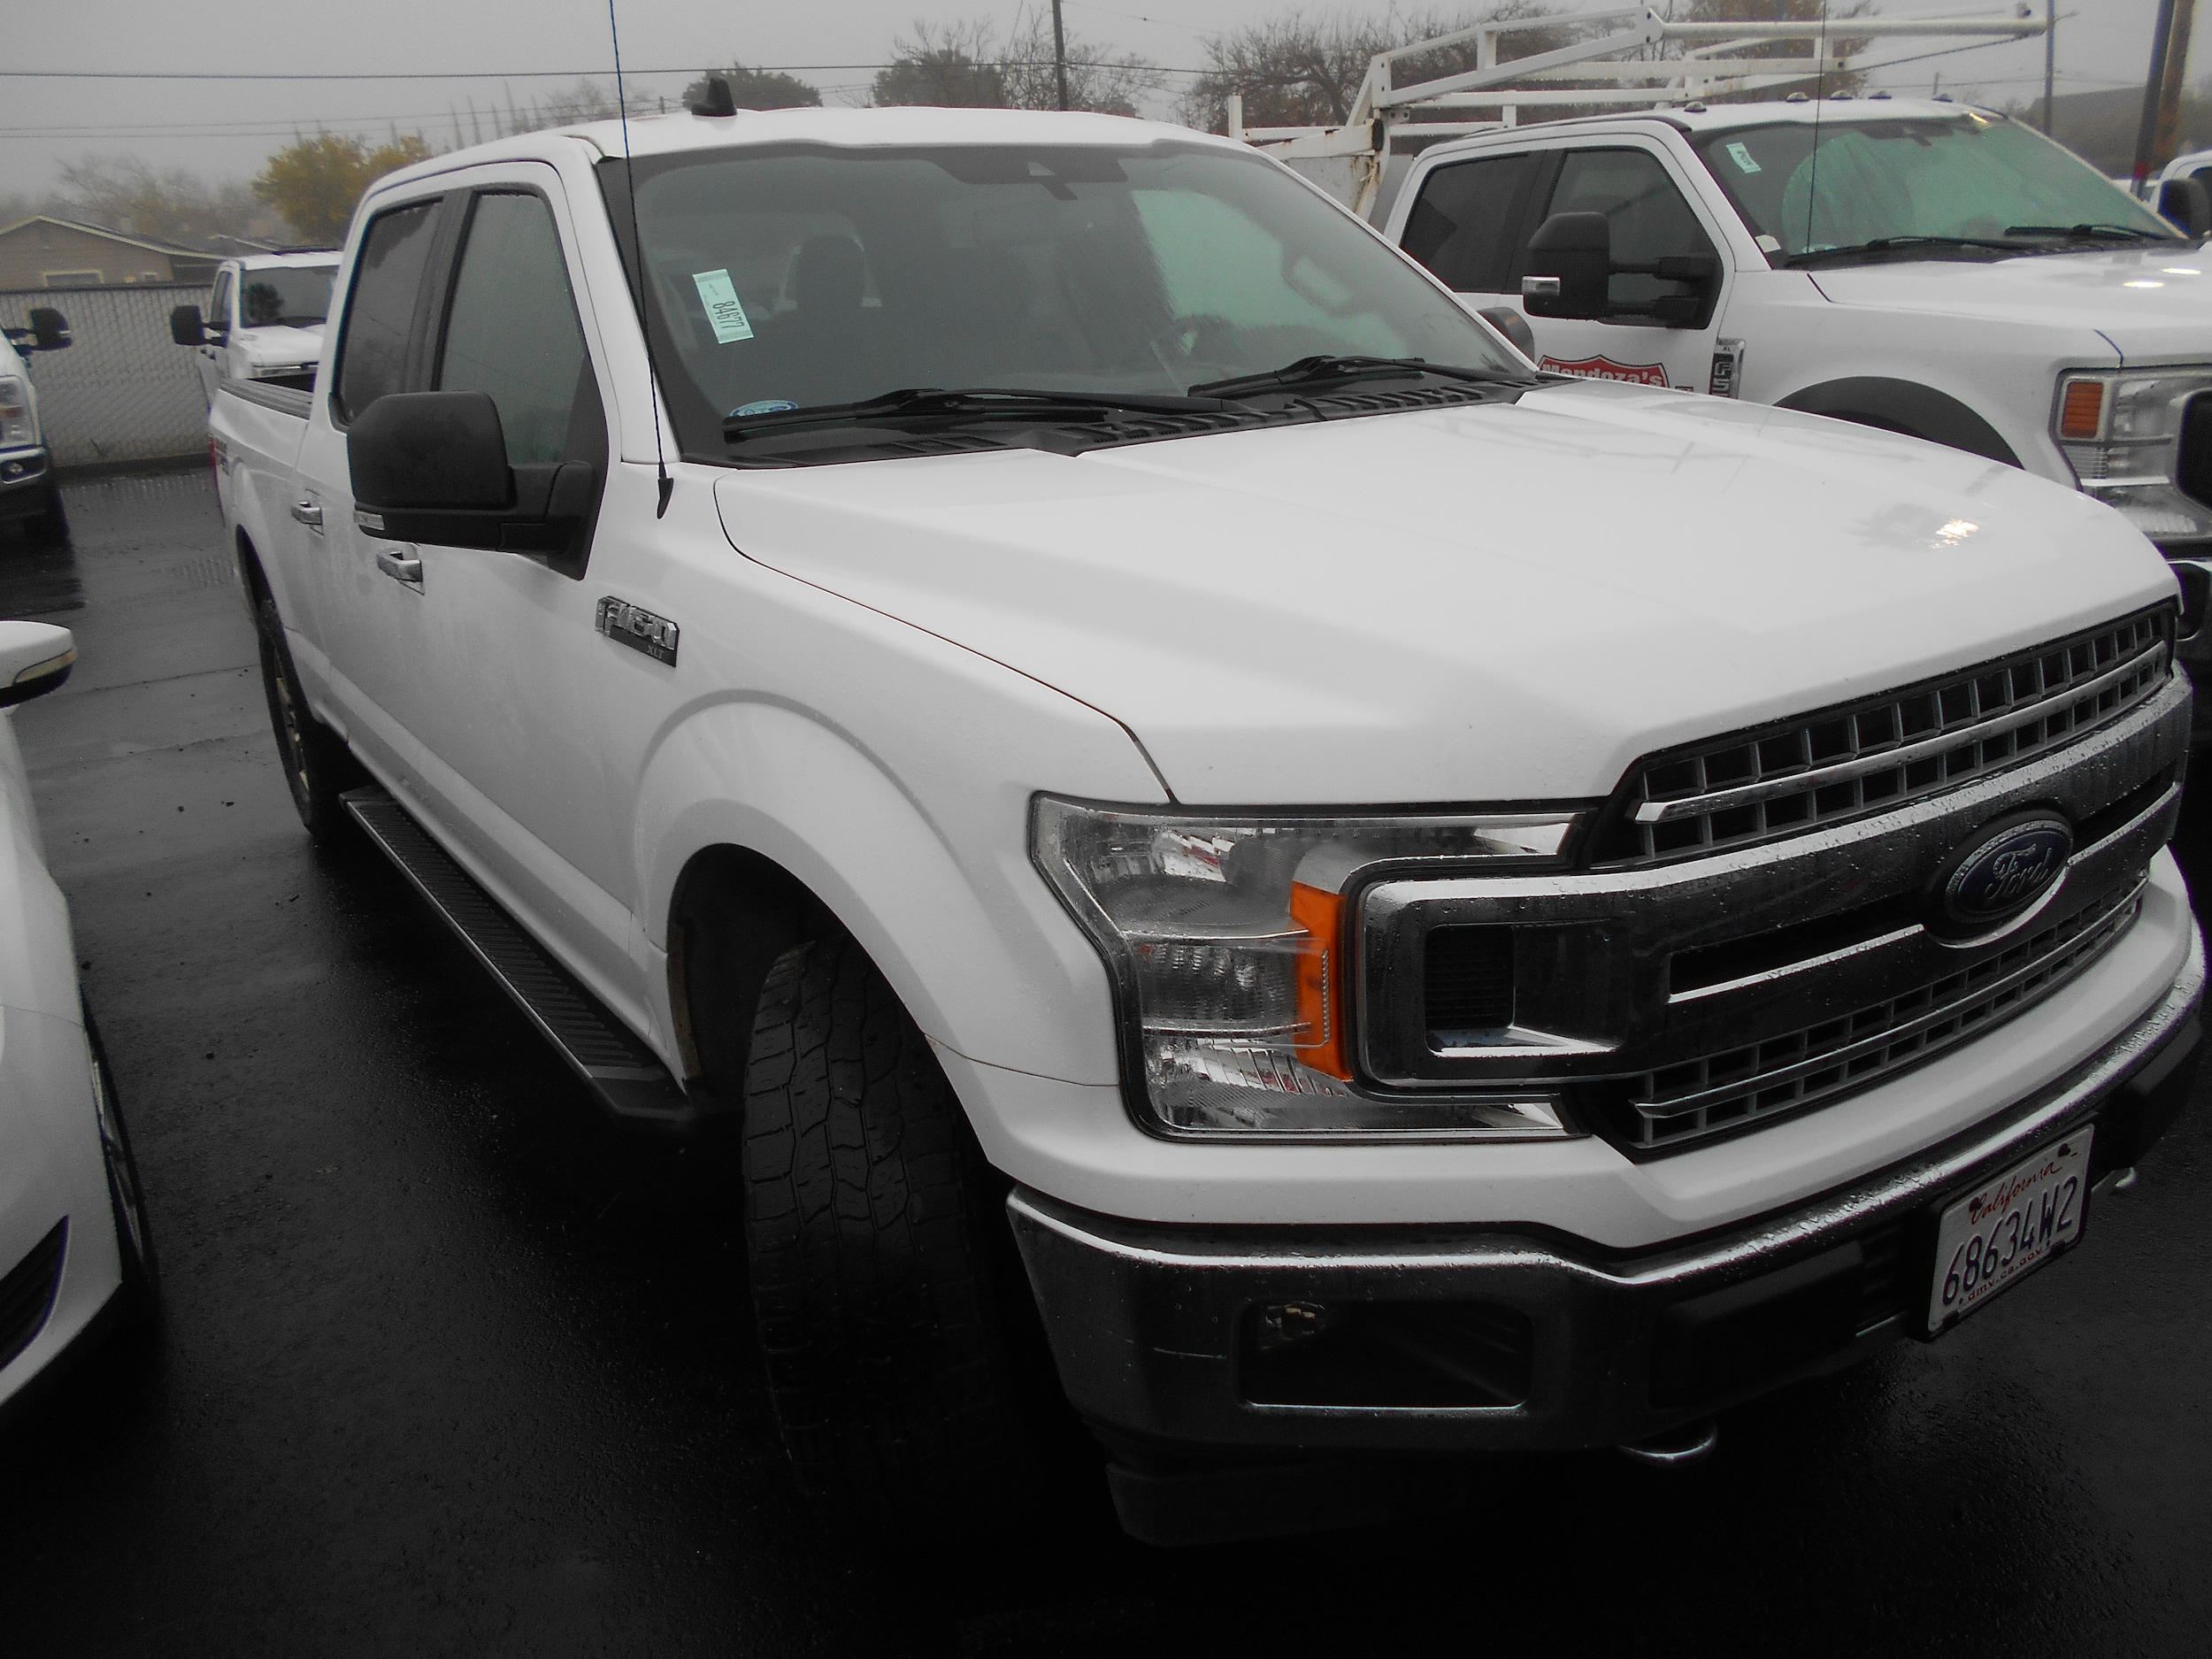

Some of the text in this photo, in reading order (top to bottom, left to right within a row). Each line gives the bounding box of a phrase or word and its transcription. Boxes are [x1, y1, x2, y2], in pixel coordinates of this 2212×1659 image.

[712, 301, 745, 329] 84677
[647, 644, 664, 659] XLT
[1985, 843, 2053, 900] Ford
[1970, 1158, 2063, 1225] California
[1942, 1176, 2078, 1306] 68634W2
